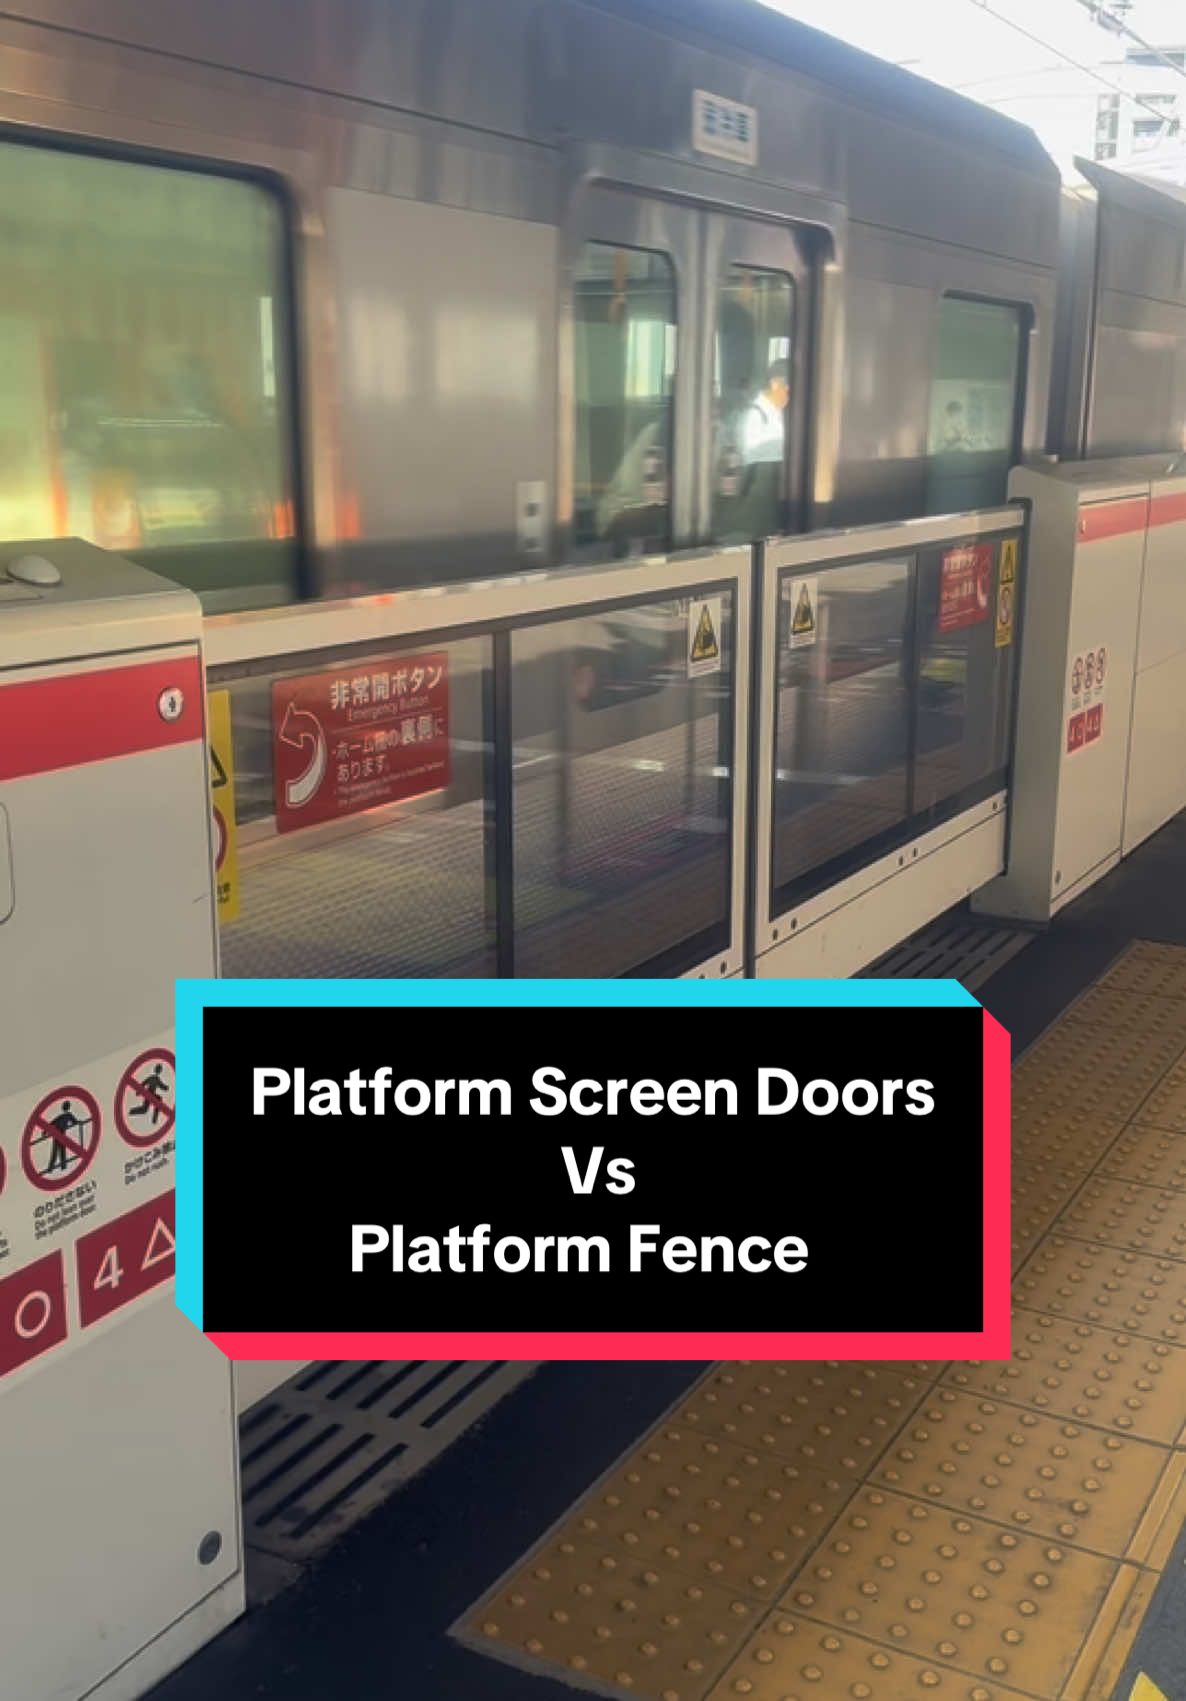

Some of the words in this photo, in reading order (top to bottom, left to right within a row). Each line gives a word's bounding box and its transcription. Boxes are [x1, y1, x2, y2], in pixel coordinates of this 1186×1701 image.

[330, 666, 442, 709] 非常開ボタン
[94, 1244, 124, 1290] 4
